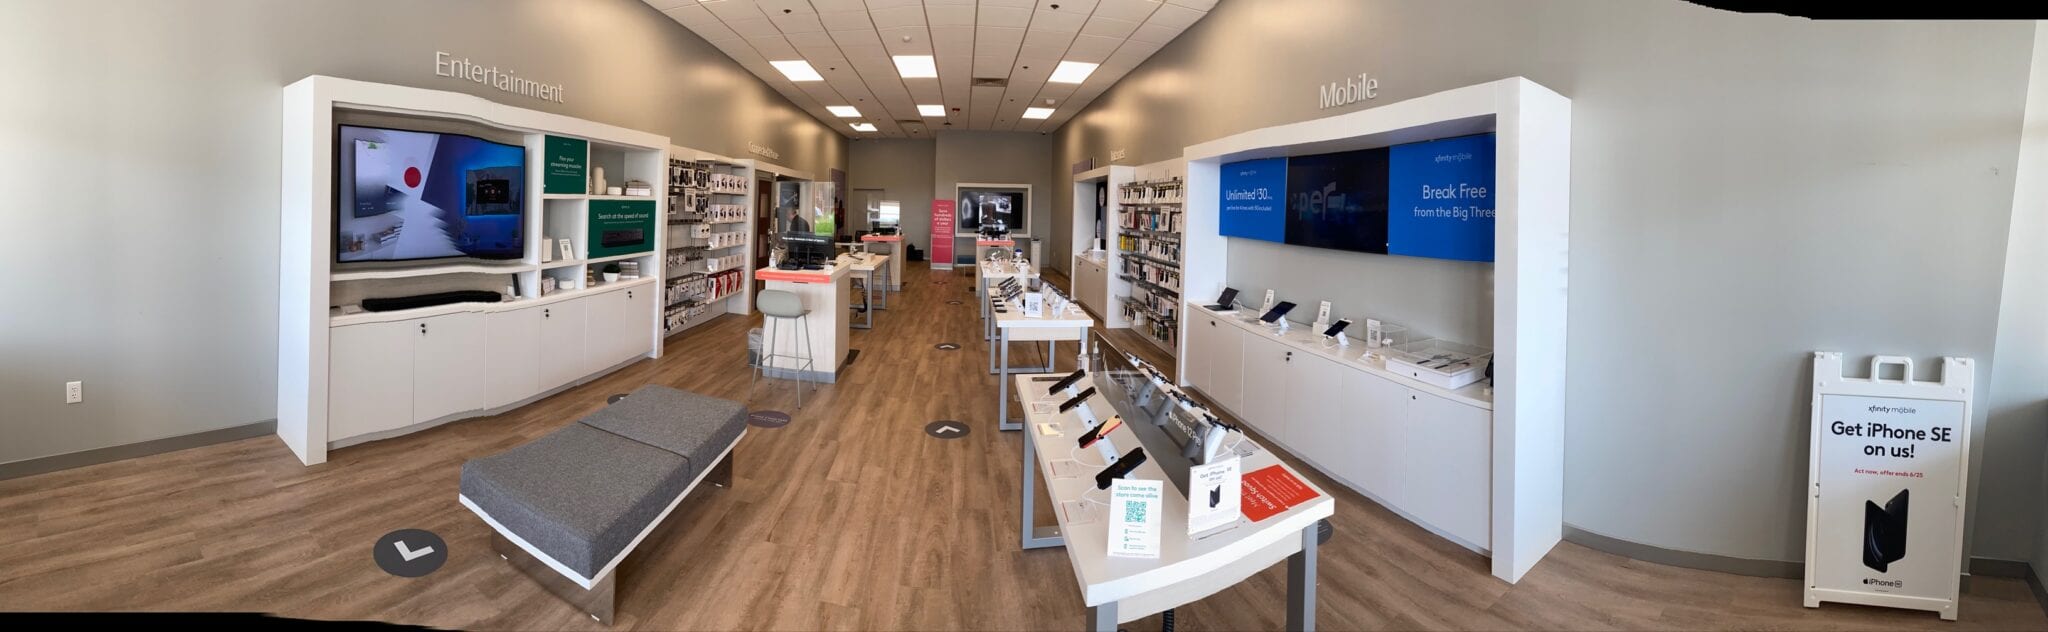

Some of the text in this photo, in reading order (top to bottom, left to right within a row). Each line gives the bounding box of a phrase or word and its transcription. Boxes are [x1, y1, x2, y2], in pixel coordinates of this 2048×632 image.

[435, 51, 564, 103] Entertainment
[1320, 72, 1378, 109] Mobile
[1225, 187, 1256, 200] Unlimited
[1422, 182, 1487, 200] Break Free
[1414, 206, 1496, 221] from the Big Three
[1868, 405, 1916, 414] xfinity mobile
[1831, 420, 1952, 442] Get iPhone SE
[1863, 444, 1915, 459] on us!
[1869, 578, 1894, 587] iPhone
